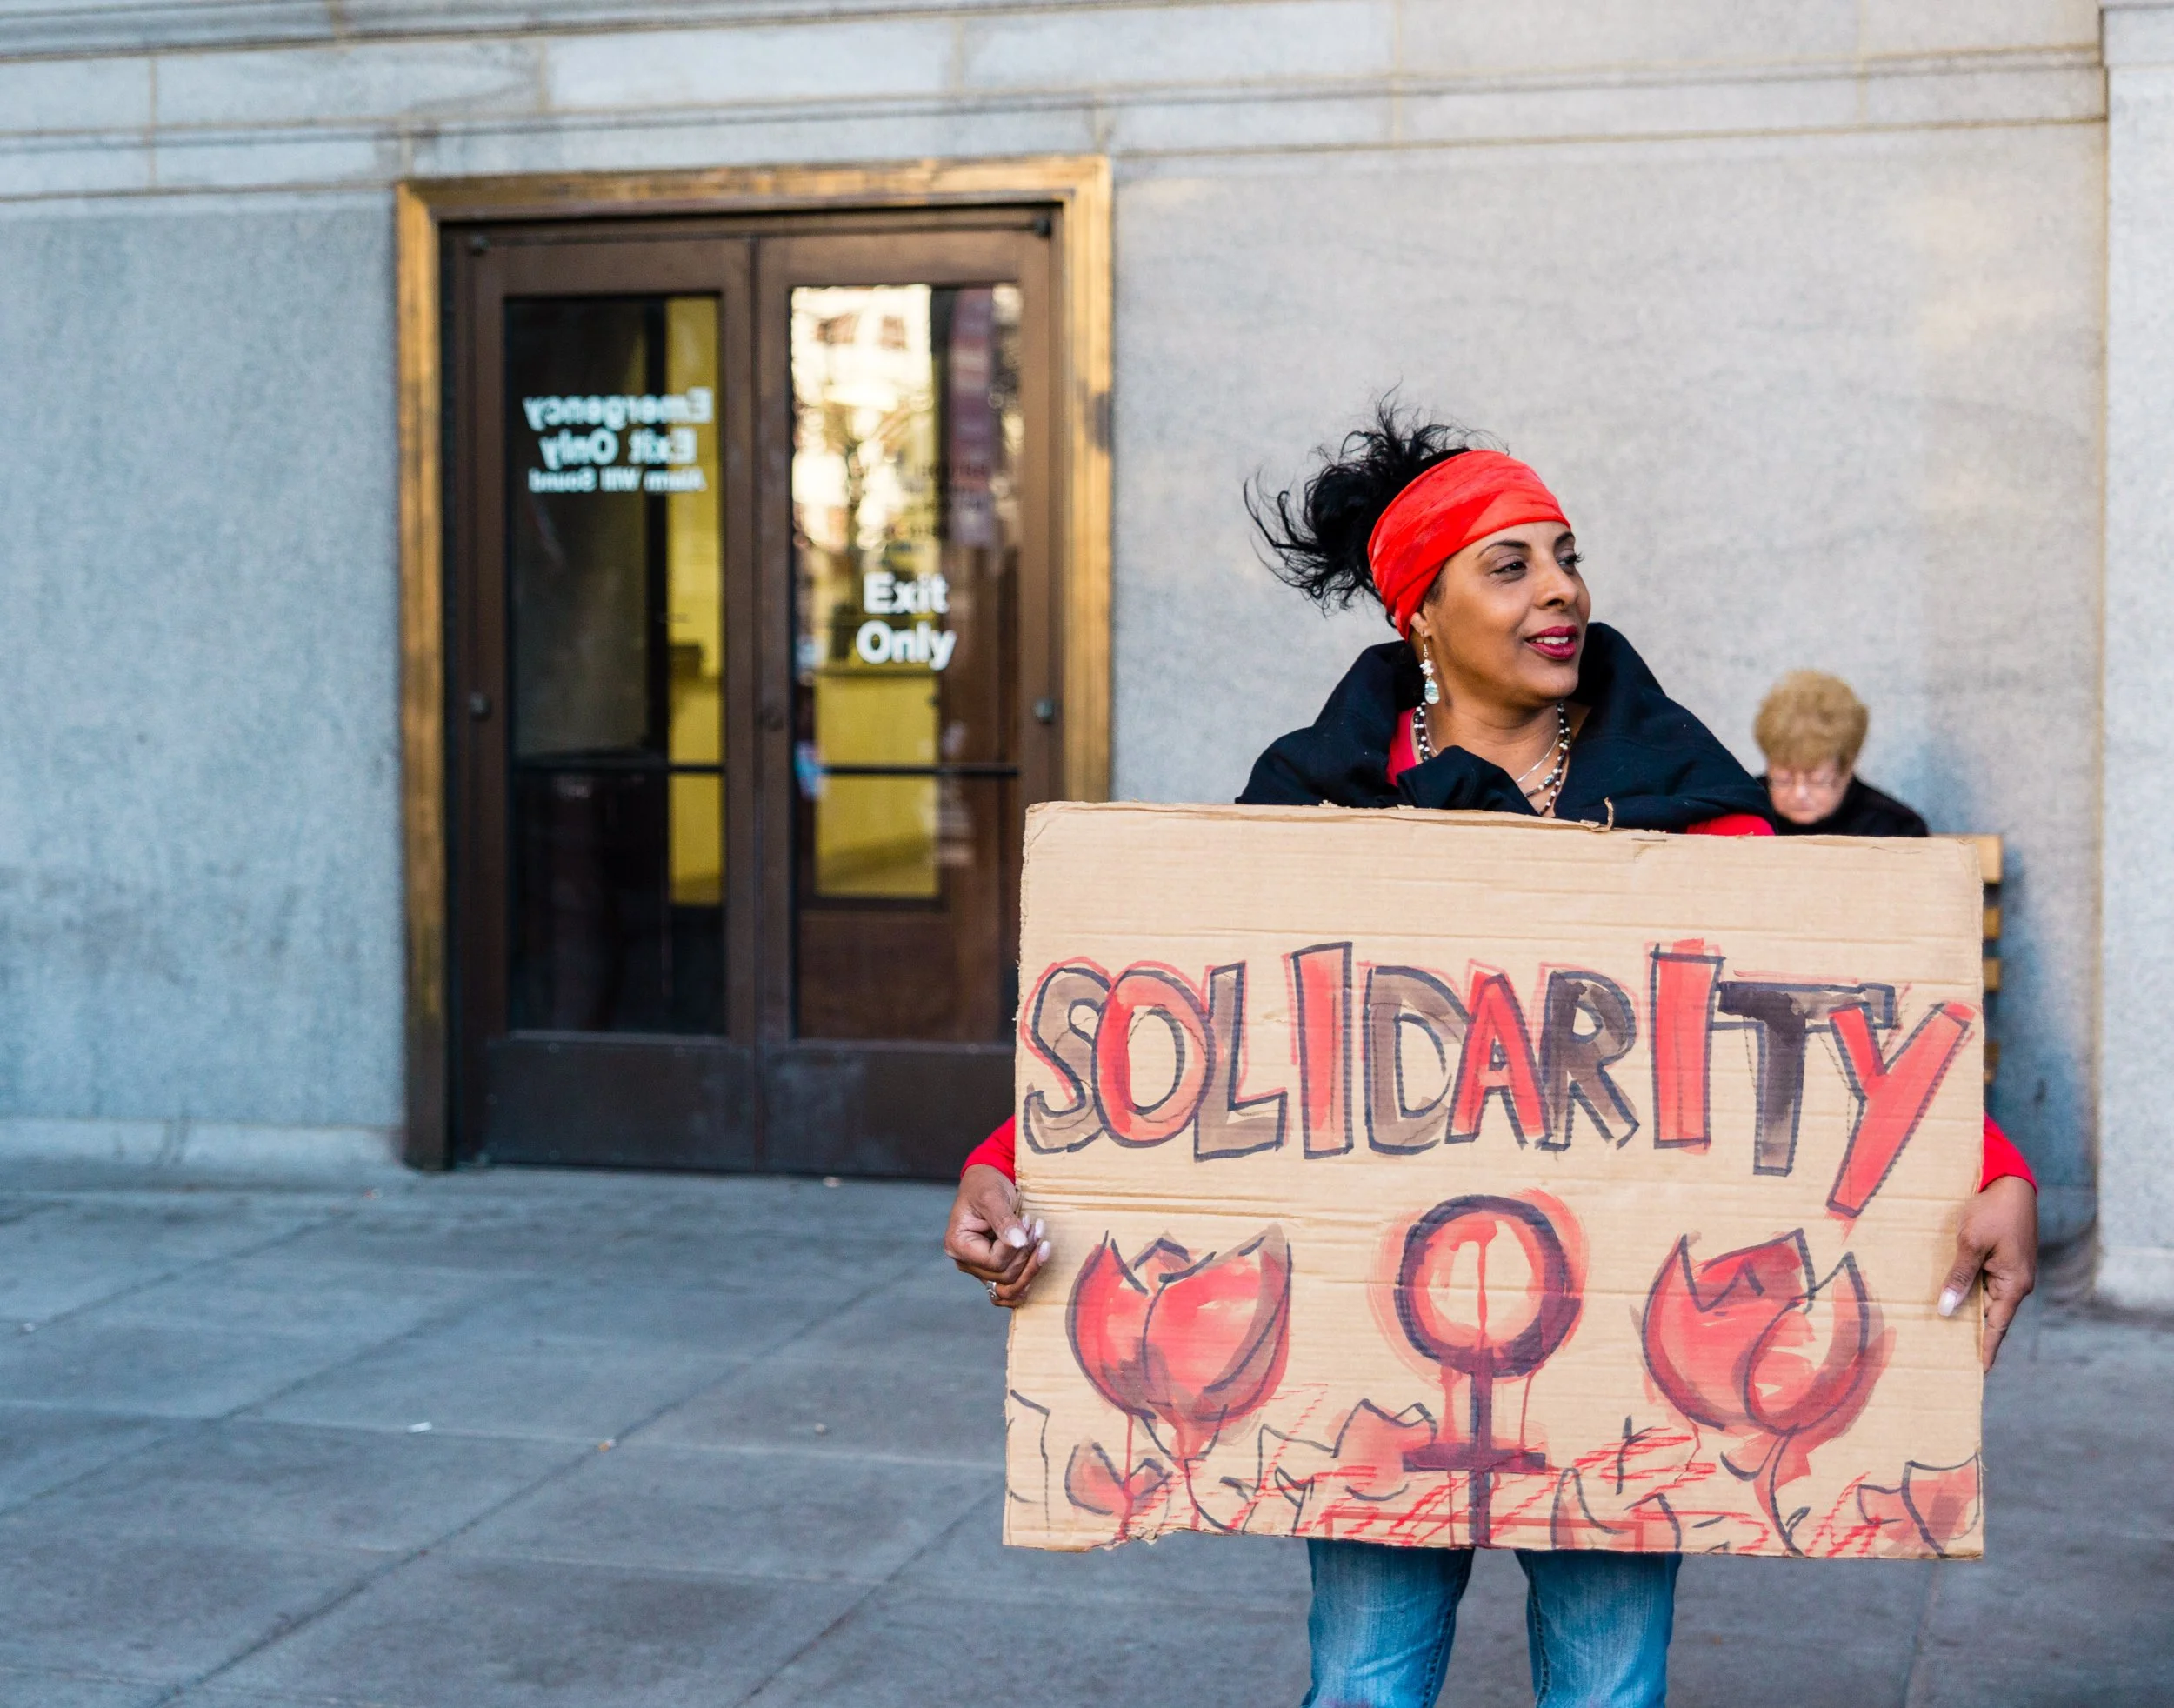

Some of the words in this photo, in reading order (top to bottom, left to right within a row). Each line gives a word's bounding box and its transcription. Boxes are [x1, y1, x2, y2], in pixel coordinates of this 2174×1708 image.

[864, 572, 949, 613] Exit
[857, 620, 956, 670] Only
[1022, 940, 1972, 1219] SOLIDARITY
